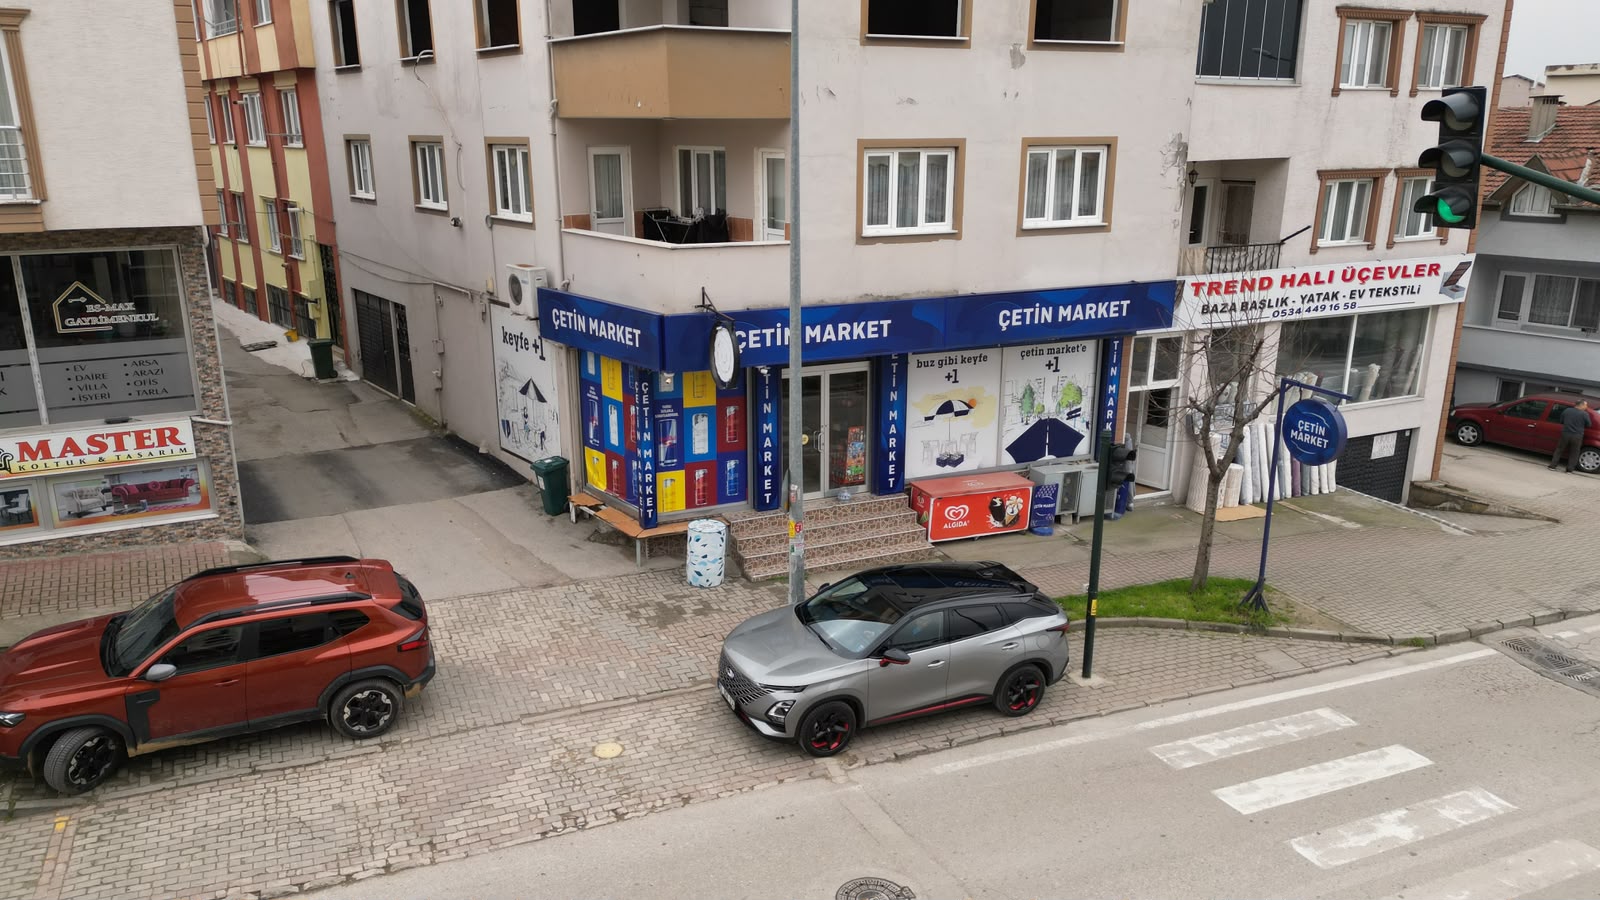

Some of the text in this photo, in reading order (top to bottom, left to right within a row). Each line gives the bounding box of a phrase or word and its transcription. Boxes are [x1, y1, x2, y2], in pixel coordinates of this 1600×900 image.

[1191, 263, 1441, 297] TREND HALI ÜÇEVLER
[1201, 302, 1237, 315] BAZA
[1300, 291, 1340, 304] YATAK
[1349, 288, 1366, 300] EV
[1272, 301, 1357, 318] 0534 449 16 58
[552, 308, 640, 347] ÇETİN MARKET
[998, 300, 1131, 331] ÇETİN MARKET
[501, 326, 546, 361] keyfe +1
[805, 319, 892, 344] MARKET
[130, 359, 159, 367] ARSA
[916, 353, 988, 368] buz gibi keyfe
[1020, 344, 1087, 360] çetin market'e
[1045, 356, 1060, 373] +1
[75, 373, 108, 382] DAİRE
[133, 367, 164, 376] ARAZİ
[945, 368, 959, 384] +1
[136, 388, 168, 396] TARLA
[1105, 339, 1119, 431] TİN MARK
[888, 353, 898, 488] ETİN MARKET
[1298, 419, 1326, 436] ÇETİN
[16, 426, 185, 463] MASTER
[763, 370, 772, 503] TİN MARKET
[1290, 429, 1329, 449] MARKET
[18, 447, 188, 472] KOLTUK & TASARIM
[641, 382, 653, 518] ÇETİN MARKET
